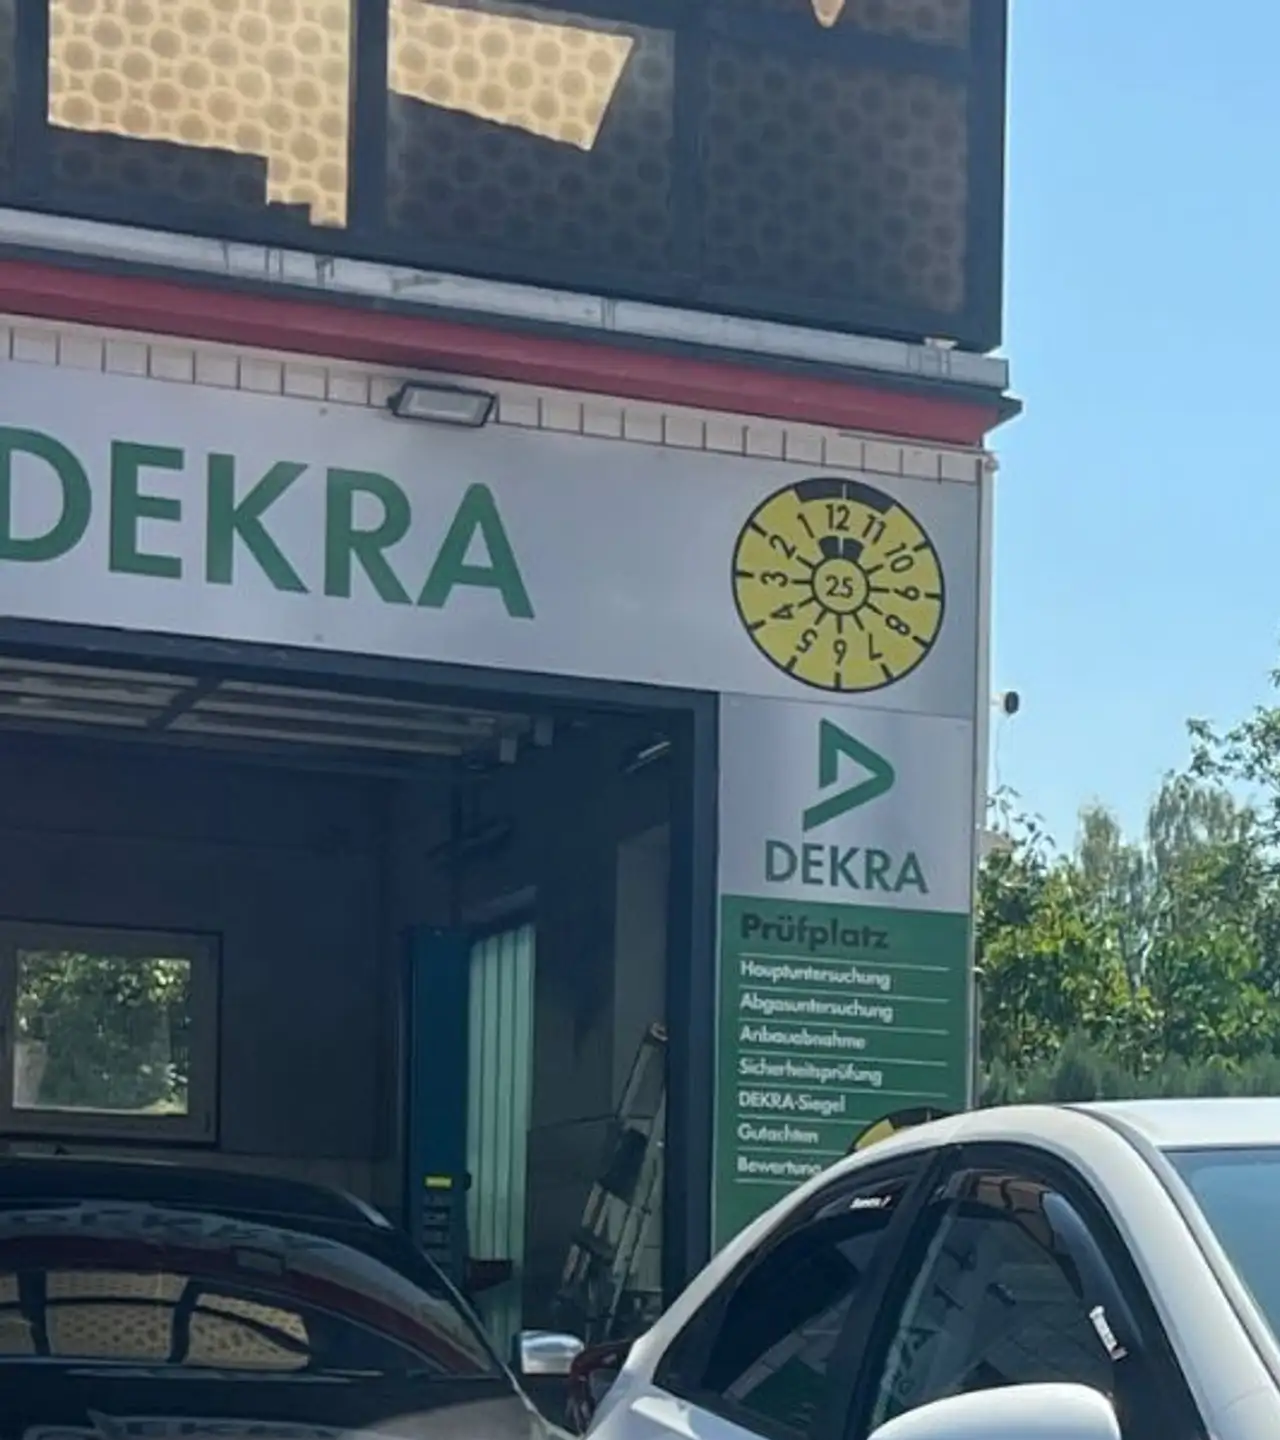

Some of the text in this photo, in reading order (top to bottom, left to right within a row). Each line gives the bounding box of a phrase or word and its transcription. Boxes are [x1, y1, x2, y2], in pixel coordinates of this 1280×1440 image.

[0, 426, 535, 619] DEKRA
[797, 513, 814, 539] 1
[825, 504, 850, 531] 12
[862, 514, 887, 545] 11
[769, 534, 796, 560] 2
[885, 542, 915, 573] 10
[761, 571, 789, 587] 3
[825, 575, 854, 598] 25
[770, 603, 794, 619] 4
[886, 614, 910, 635] 8
[796, 629, 818, 653] 5
[766, 840, 929, 893] DEKRA
[740, 913, 889, 950] Prüfplatz
[740, 960, 891, 990] Hauptuntersuchung
[740, 993, 894, 1022] Abgasuntersuchung
[739, 1026, 866, 1049] Anbauabnahme
[739, 1059, 882, 1087] Sicherheitsprüfung
[738, 1091, 845, 1115] DEKRA-Siegel
[737, 1124, 818, 1144] Gutachten
